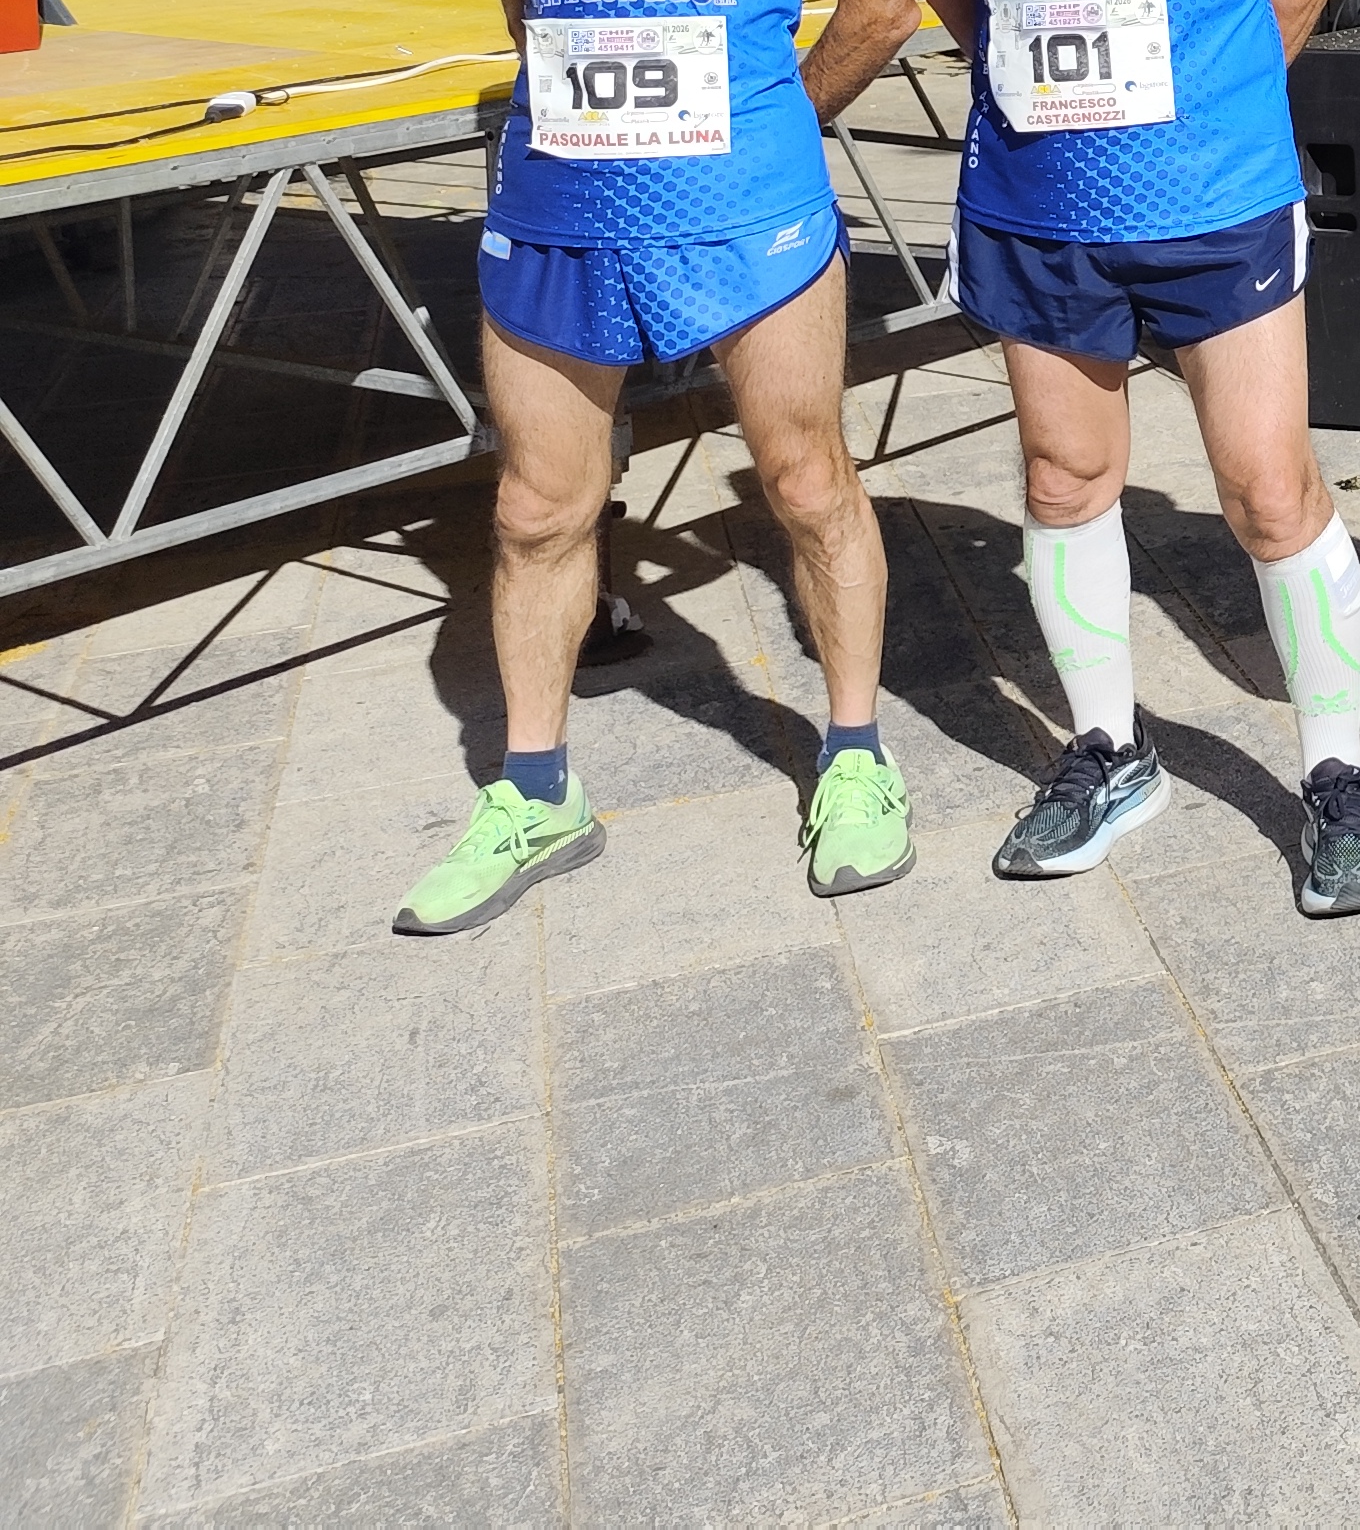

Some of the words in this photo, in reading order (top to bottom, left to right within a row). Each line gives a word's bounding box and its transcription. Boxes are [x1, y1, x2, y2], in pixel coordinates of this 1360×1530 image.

[598, 28, 635, 37] CHIP
[671, 25, 690, 34] 2026
[597, 44, 635, 53] 4519411
[1028, 30, 1112, 84] 101
[566, 59, 679, 110] 109
[1032, 96, 1117, 112] FRANCESCO
[1027, 109, 1126, 125] CASTAGNOZZI
[540, 132, 628, 147] PASQUALE
[636, 131, 661, 146] LA
[669, 129, 724, 145] LUNA
[767, 235, 811, 257] GIOSPORT
